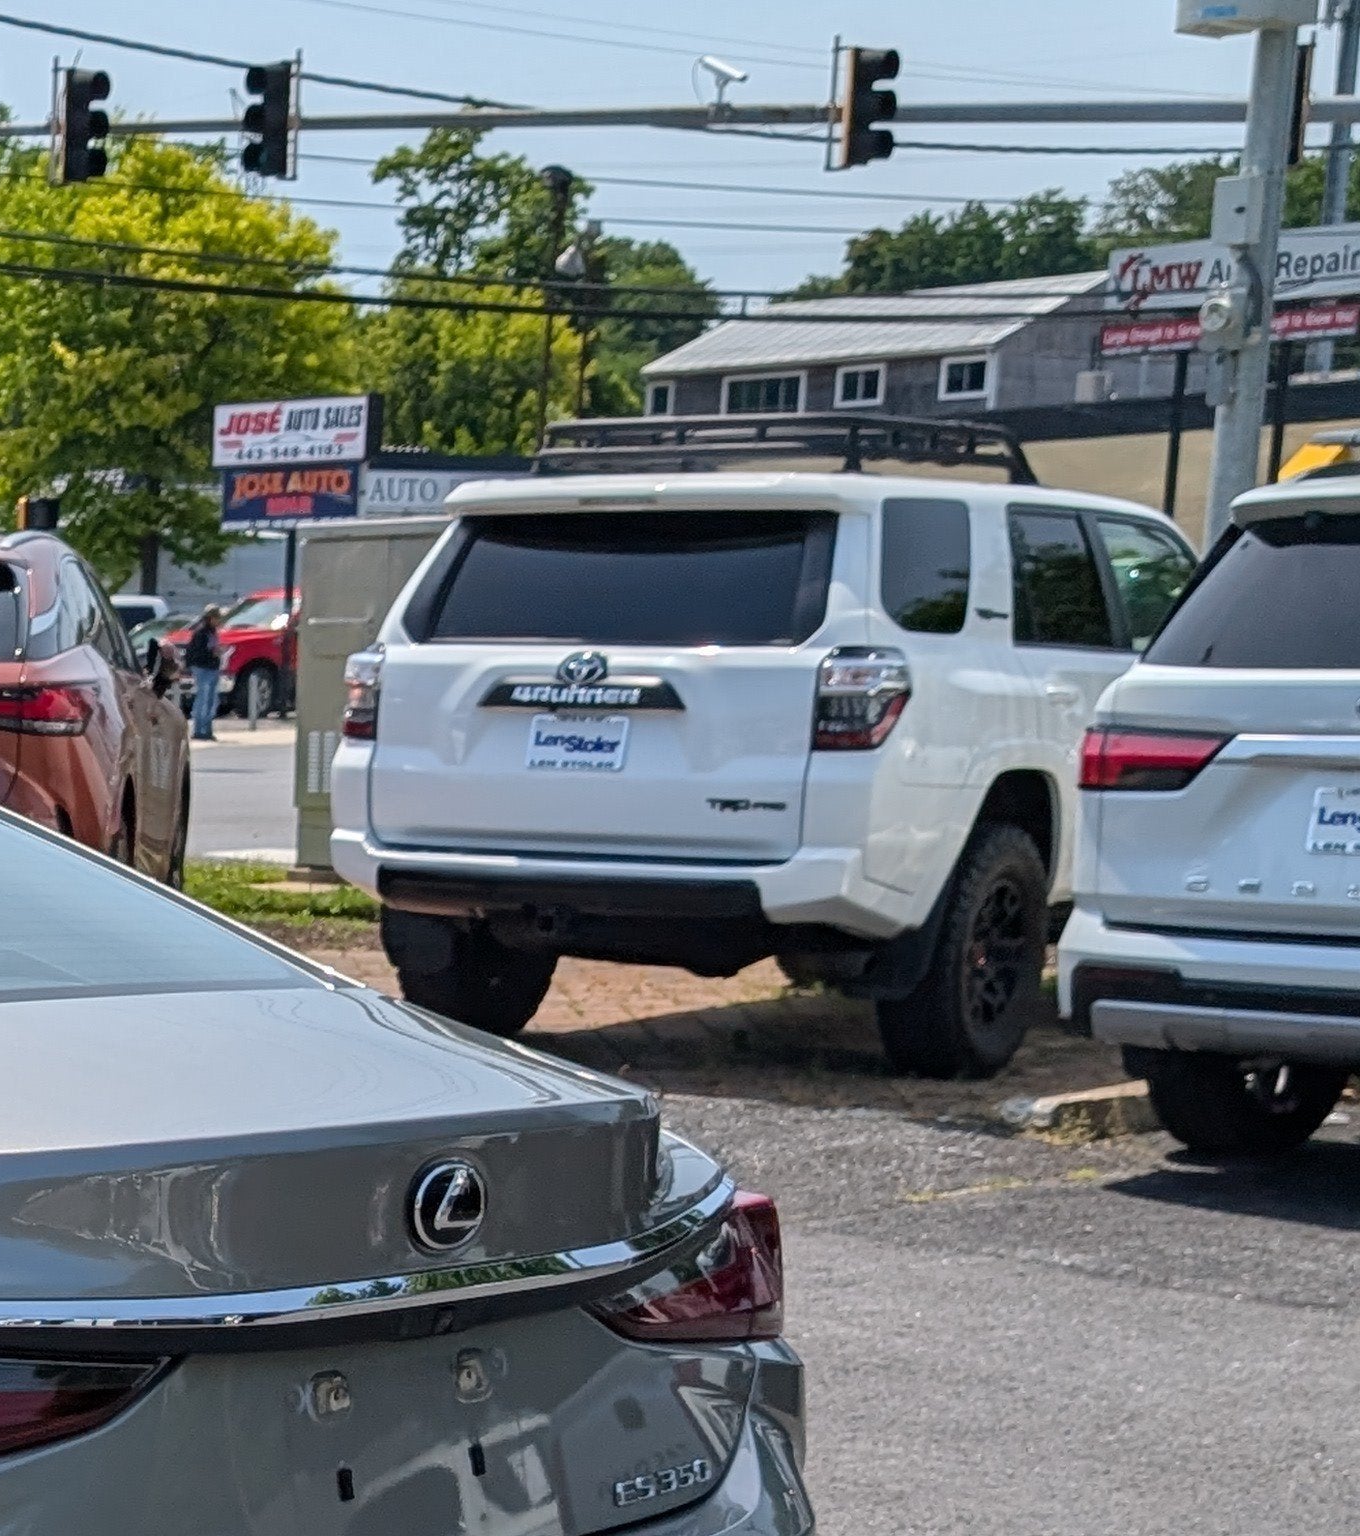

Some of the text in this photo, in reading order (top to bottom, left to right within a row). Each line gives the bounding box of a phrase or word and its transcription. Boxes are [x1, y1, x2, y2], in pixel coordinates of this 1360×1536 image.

[1276, 244, 1360, 279] Repair
[219, 402, 363, 436] JOSÉ AUTO SALES
[286, 468, 352, 495] AUTO
[368, 477, 439, 503] AUTO
